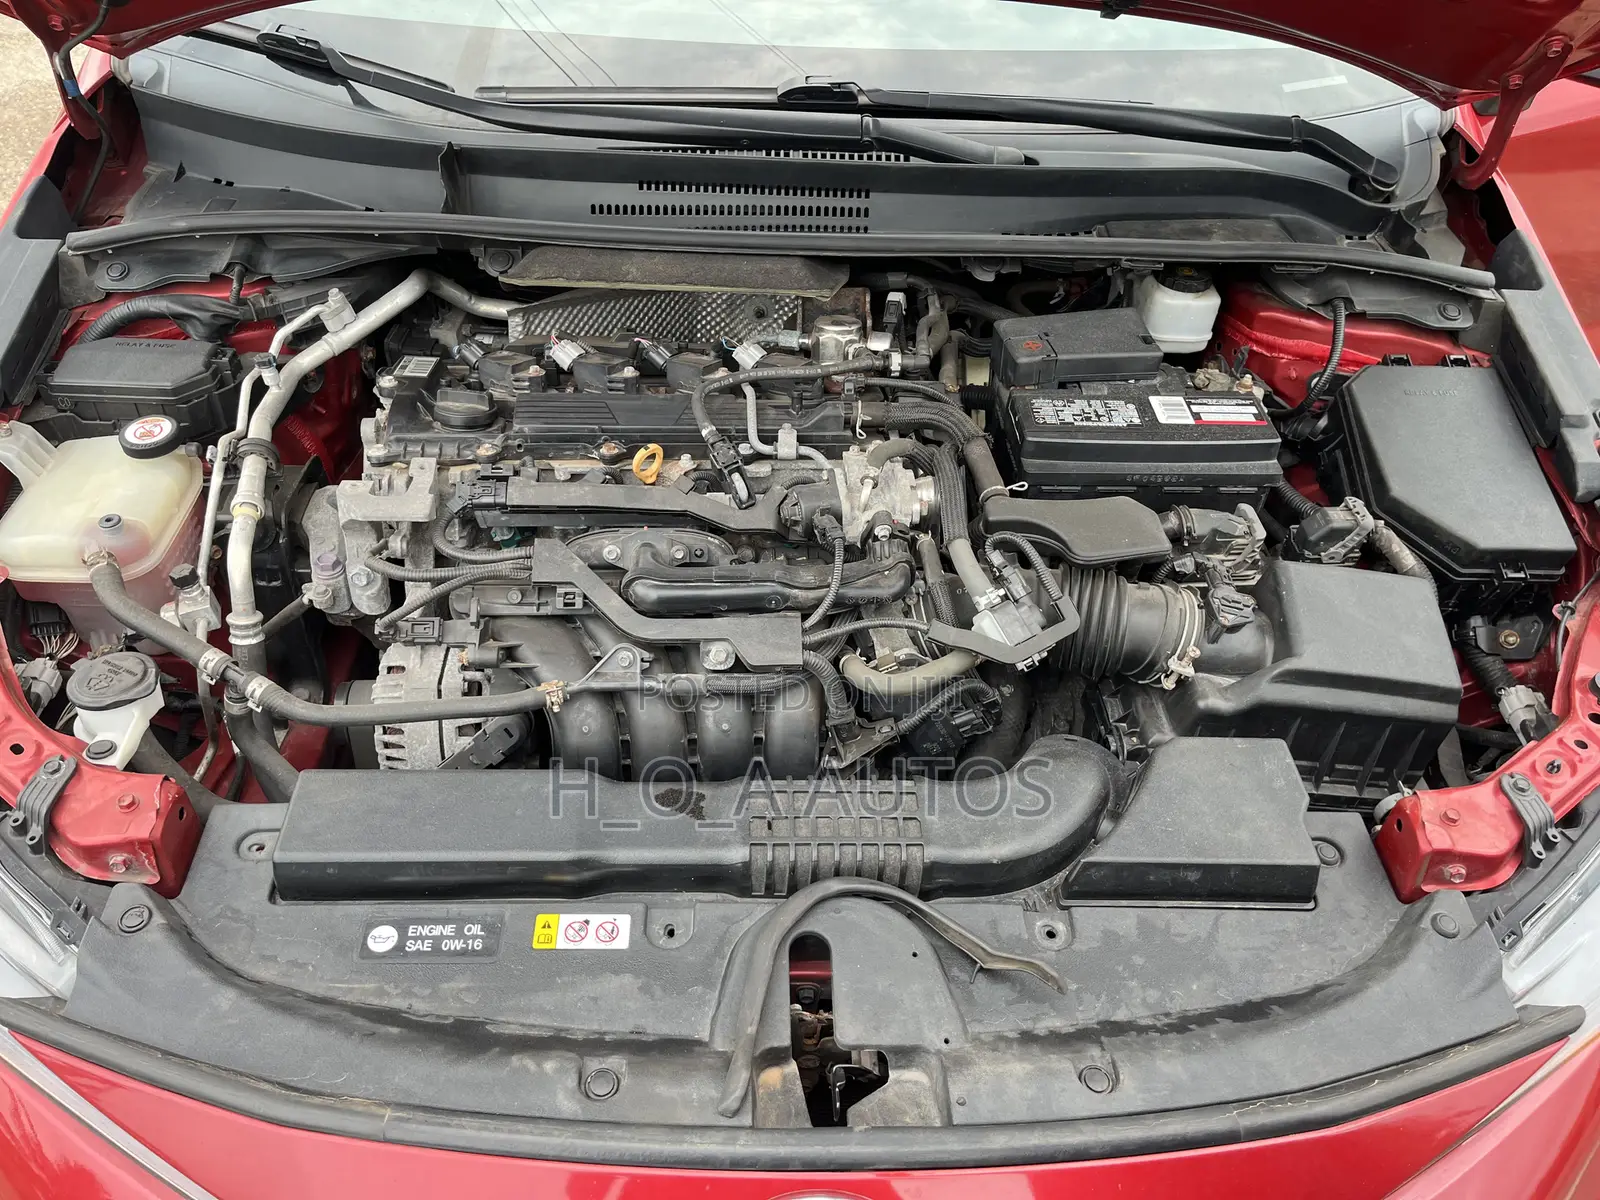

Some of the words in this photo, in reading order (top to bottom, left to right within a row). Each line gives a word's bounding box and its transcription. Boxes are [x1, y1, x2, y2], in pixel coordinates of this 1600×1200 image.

[408, 925, 456, 936] ENGINE
[464, 924, 485, 935] OIL
[405, 940, 433, 951] SAE
[441, 938, 483, 951] 0W-16
